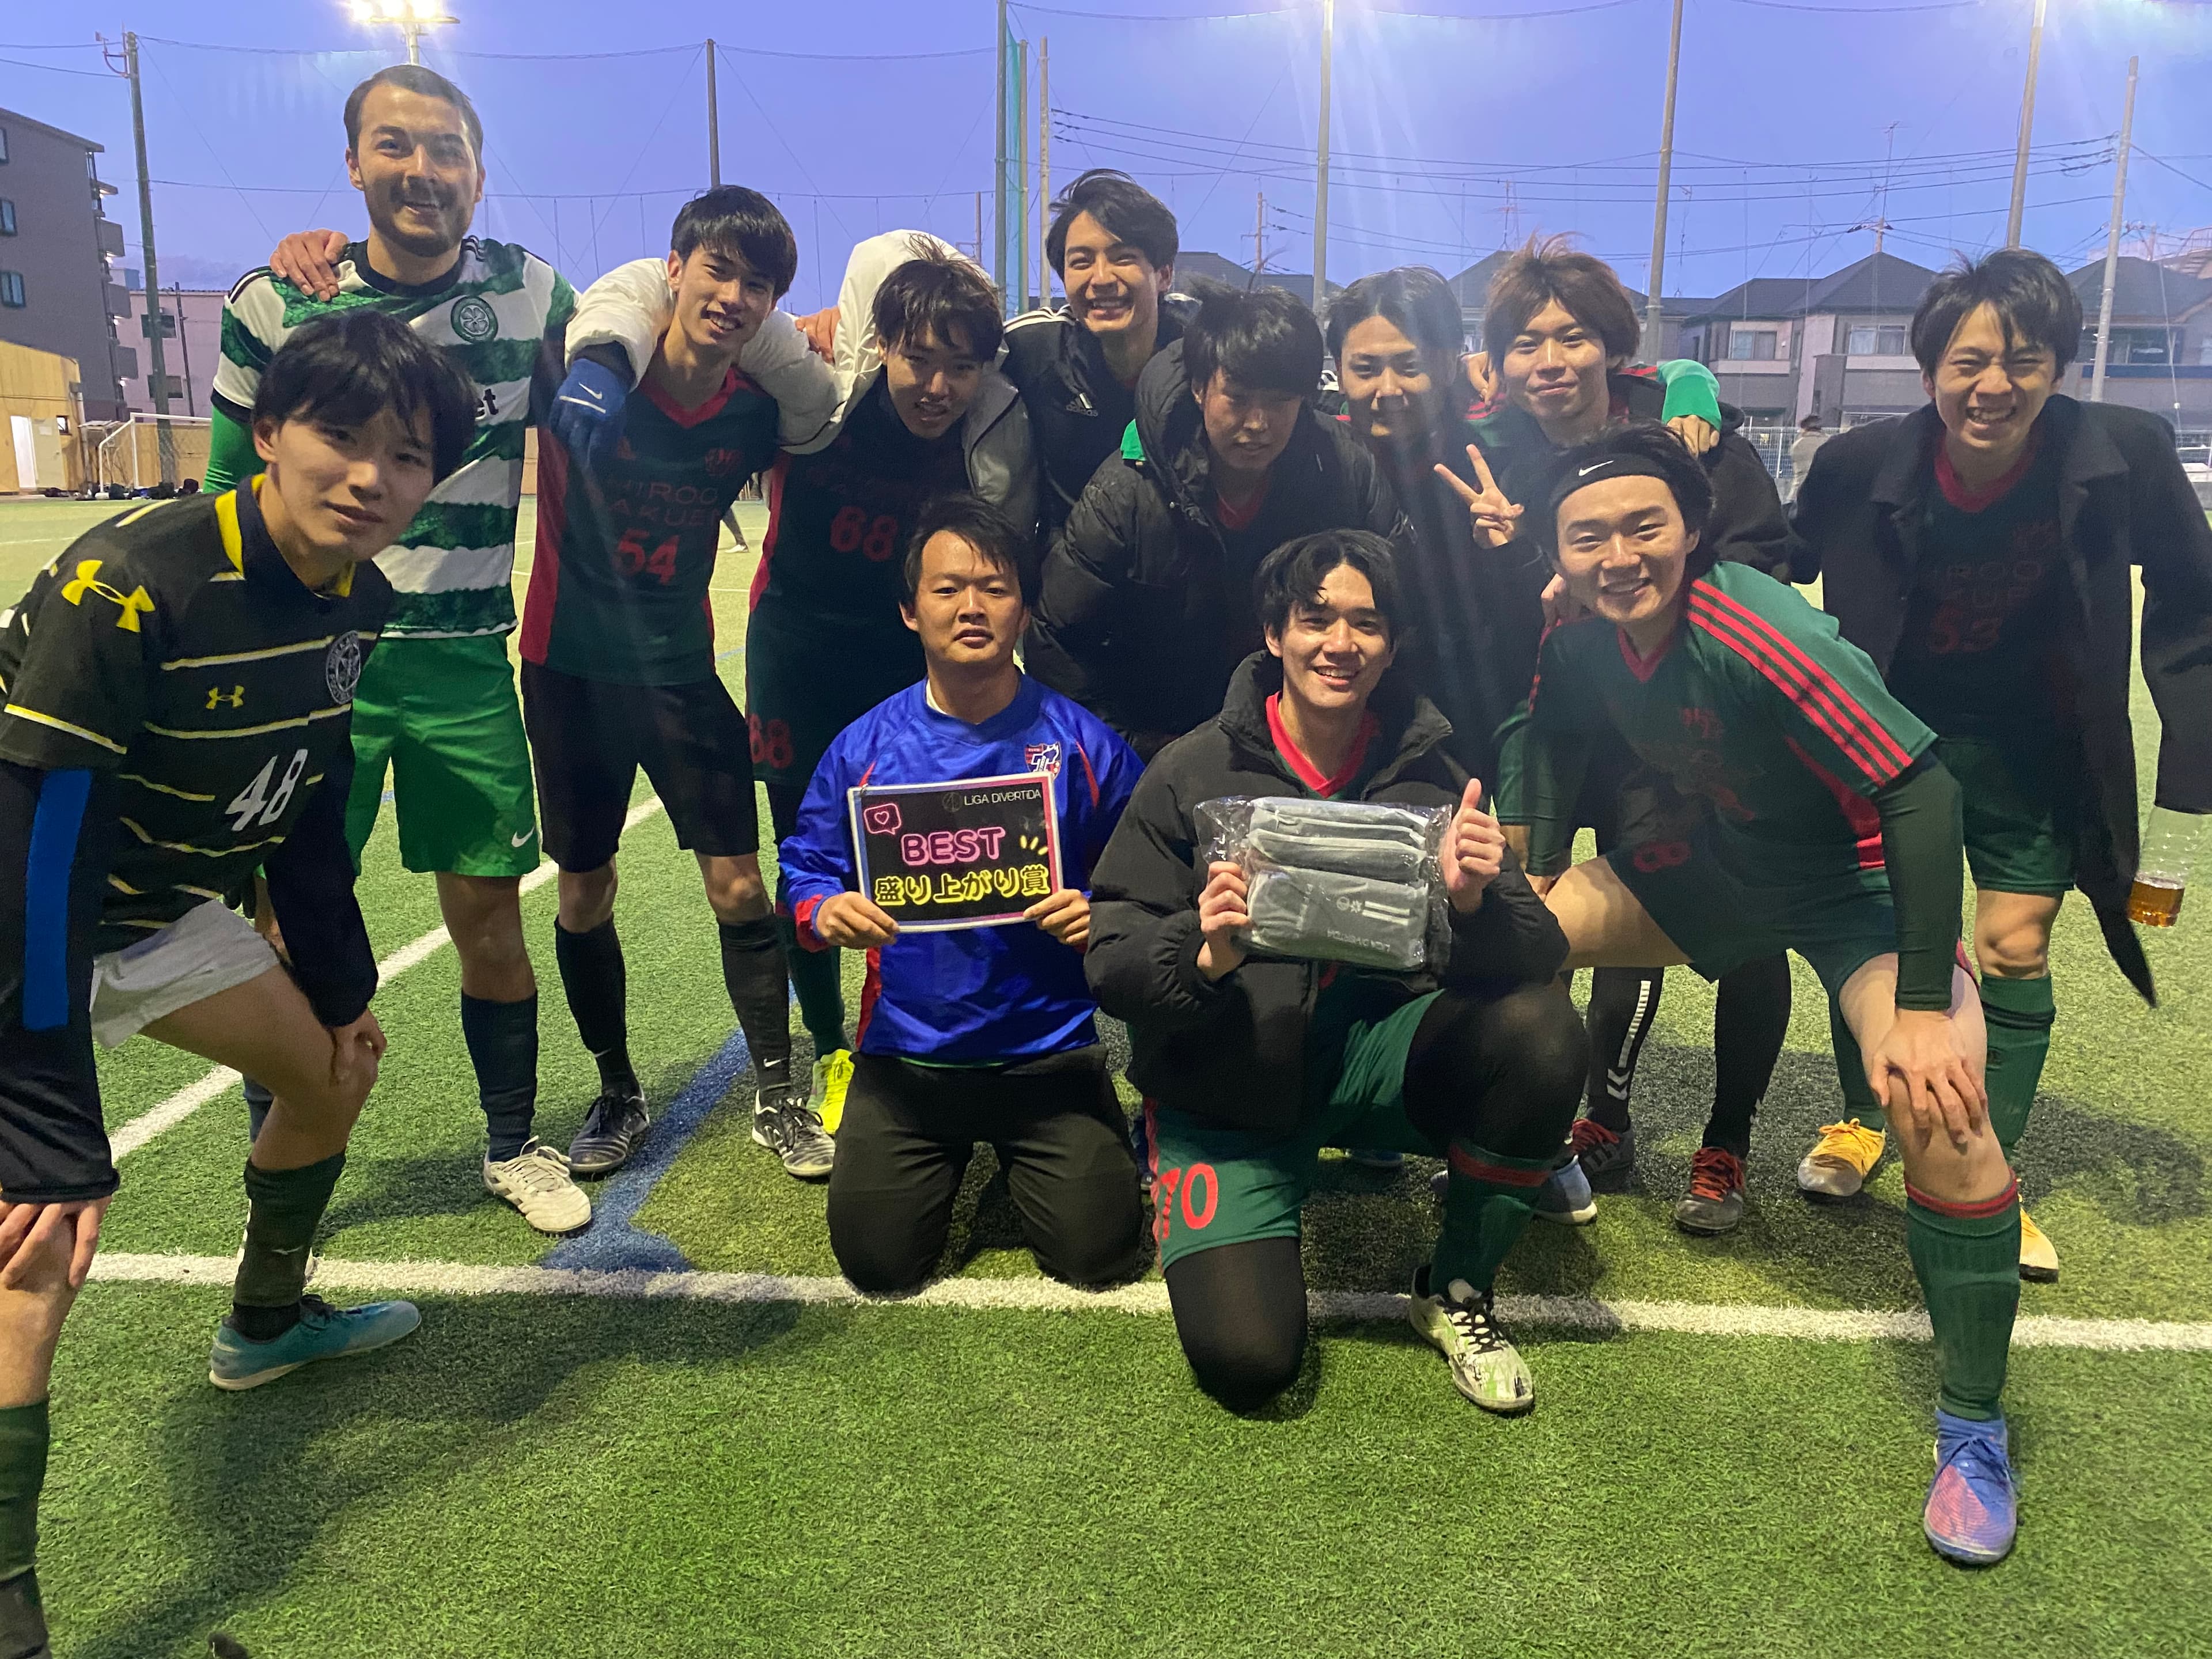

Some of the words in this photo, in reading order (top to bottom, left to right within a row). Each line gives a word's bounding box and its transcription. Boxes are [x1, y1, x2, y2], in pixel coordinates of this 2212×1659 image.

[225, 749, 308, 831] 48
[901, 827, 1006, 866] BEST
[875, 864, 1051, 905] 盛り上がり賞
[1160, 1162, 1218, 1240] 70
